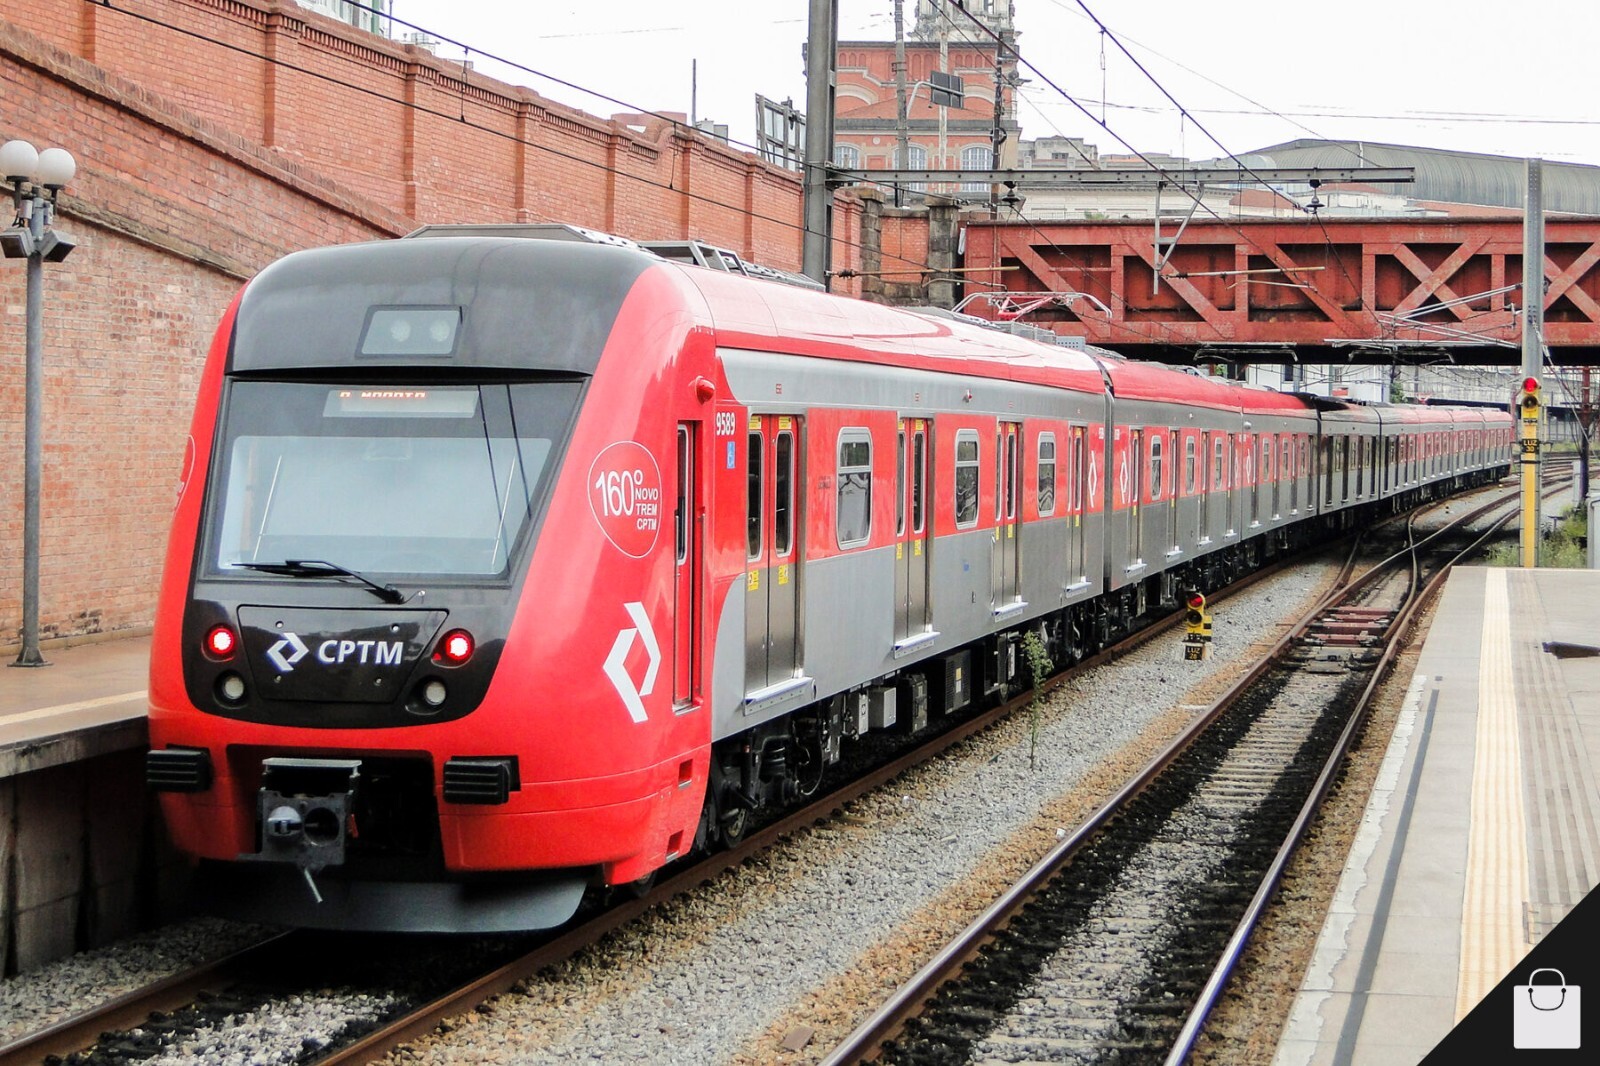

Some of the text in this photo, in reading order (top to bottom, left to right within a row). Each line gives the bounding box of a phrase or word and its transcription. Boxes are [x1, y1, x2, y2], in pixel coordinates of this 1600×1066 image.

[716, 412, 736, 436] 9589
[635, 488, 659, 500] NOVO
[636, 503, 657, 516] TREM
[636, 518, 657, 530] CPTM
[317, 639, 404, 664] CPTM
